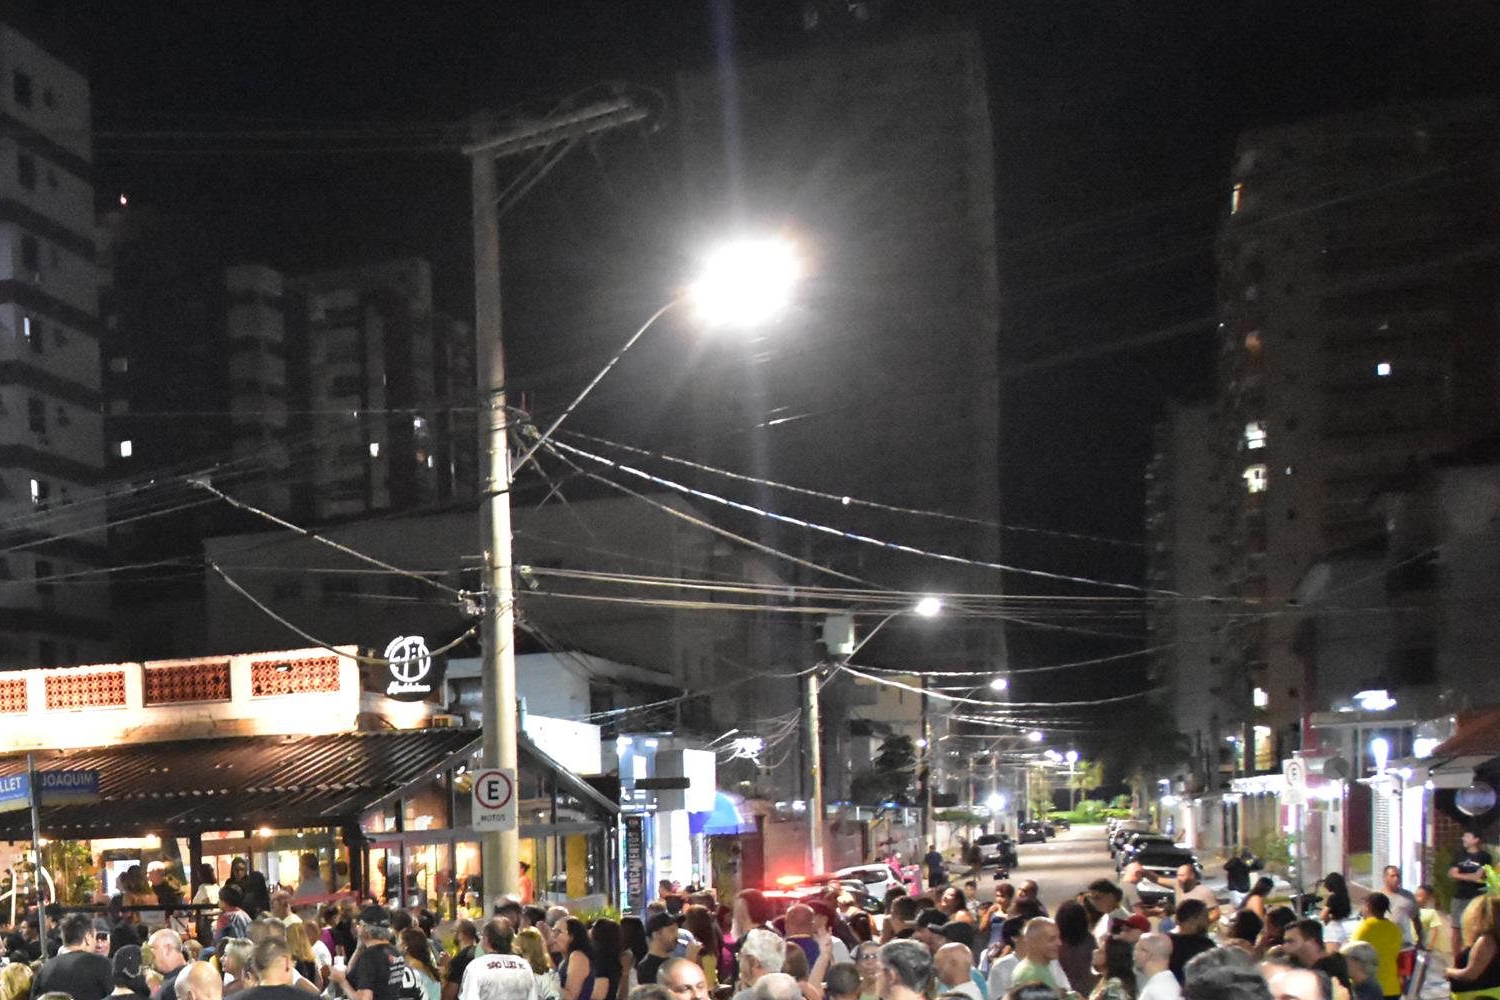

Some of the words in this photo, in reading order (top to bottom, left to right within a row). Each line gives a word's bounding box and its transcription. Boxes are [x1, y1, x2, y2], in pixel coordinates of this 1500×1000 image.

[43, 774, 93, 786] JOAQUIM
[488, 781, 499, 800] E
[481, 814, 506, 822] MOTOS
